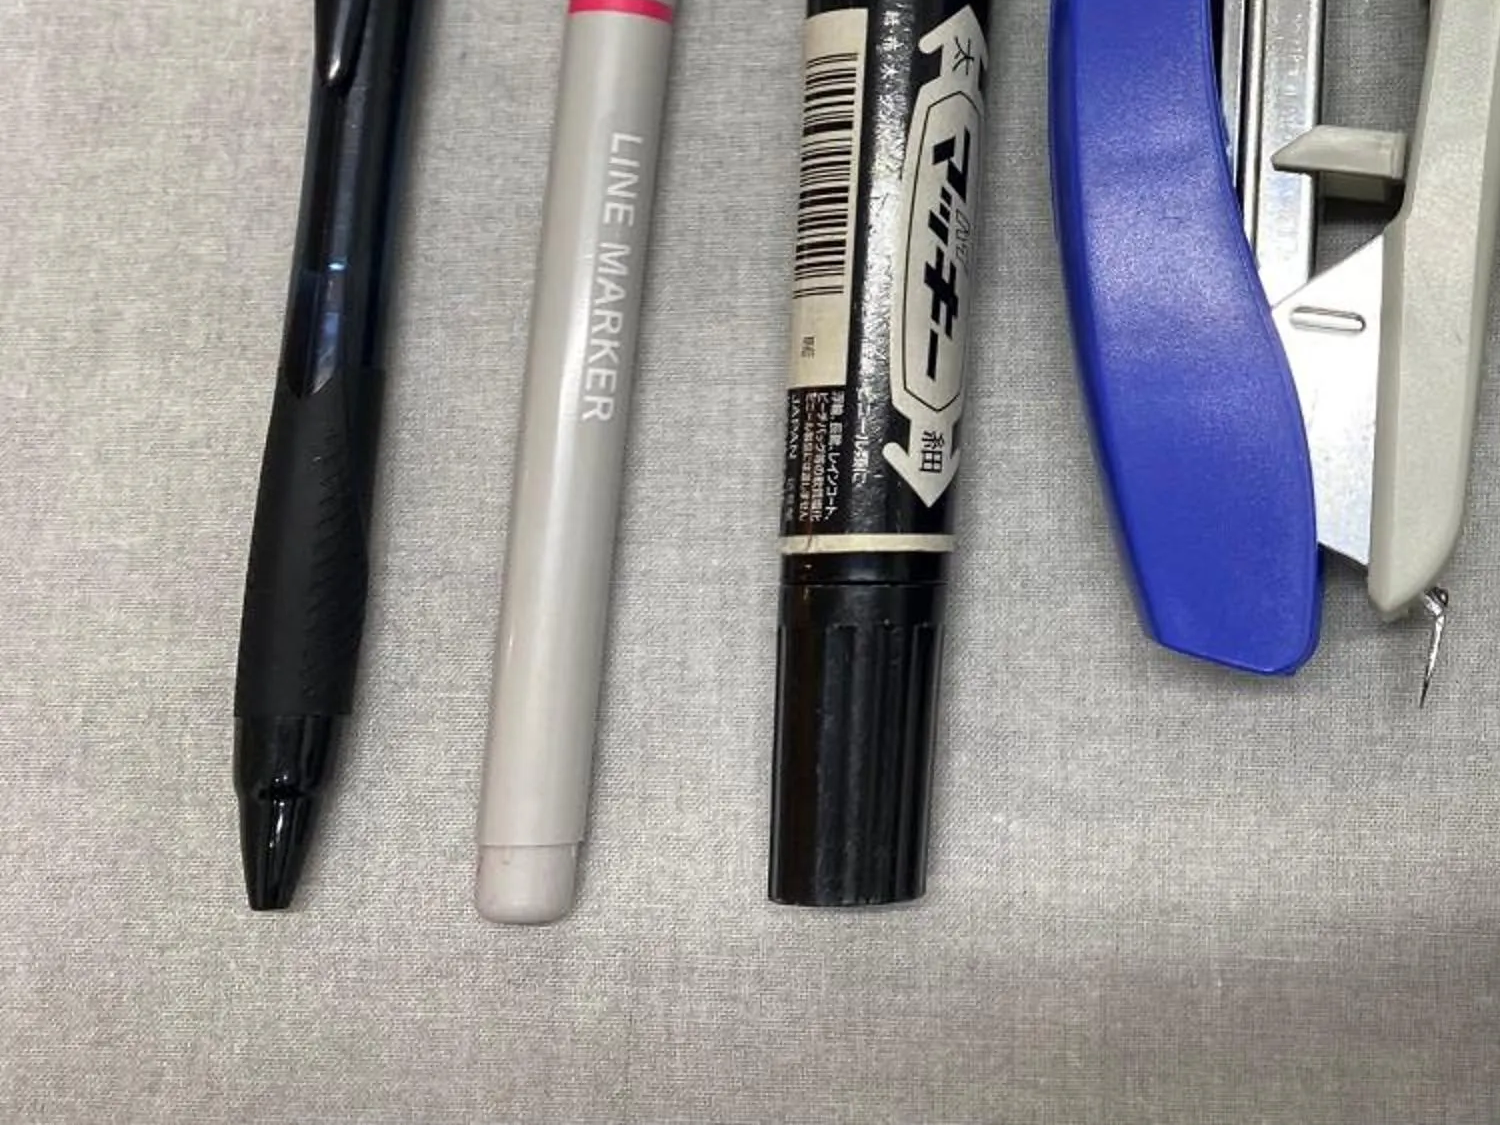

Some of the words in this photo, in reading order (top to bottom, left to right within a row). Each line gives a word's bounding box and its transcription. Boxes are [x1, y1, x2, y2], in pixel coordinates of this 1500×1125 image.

[952, 36, 974, 75] 太
[602, 132, 643, 227] LINE
[924, 126, 971, 381] マッキー
[582, 241, 631, 422] MARKER
[788, 393, 801, 459] JAPAN
[919, 429, 945, 473] 細
